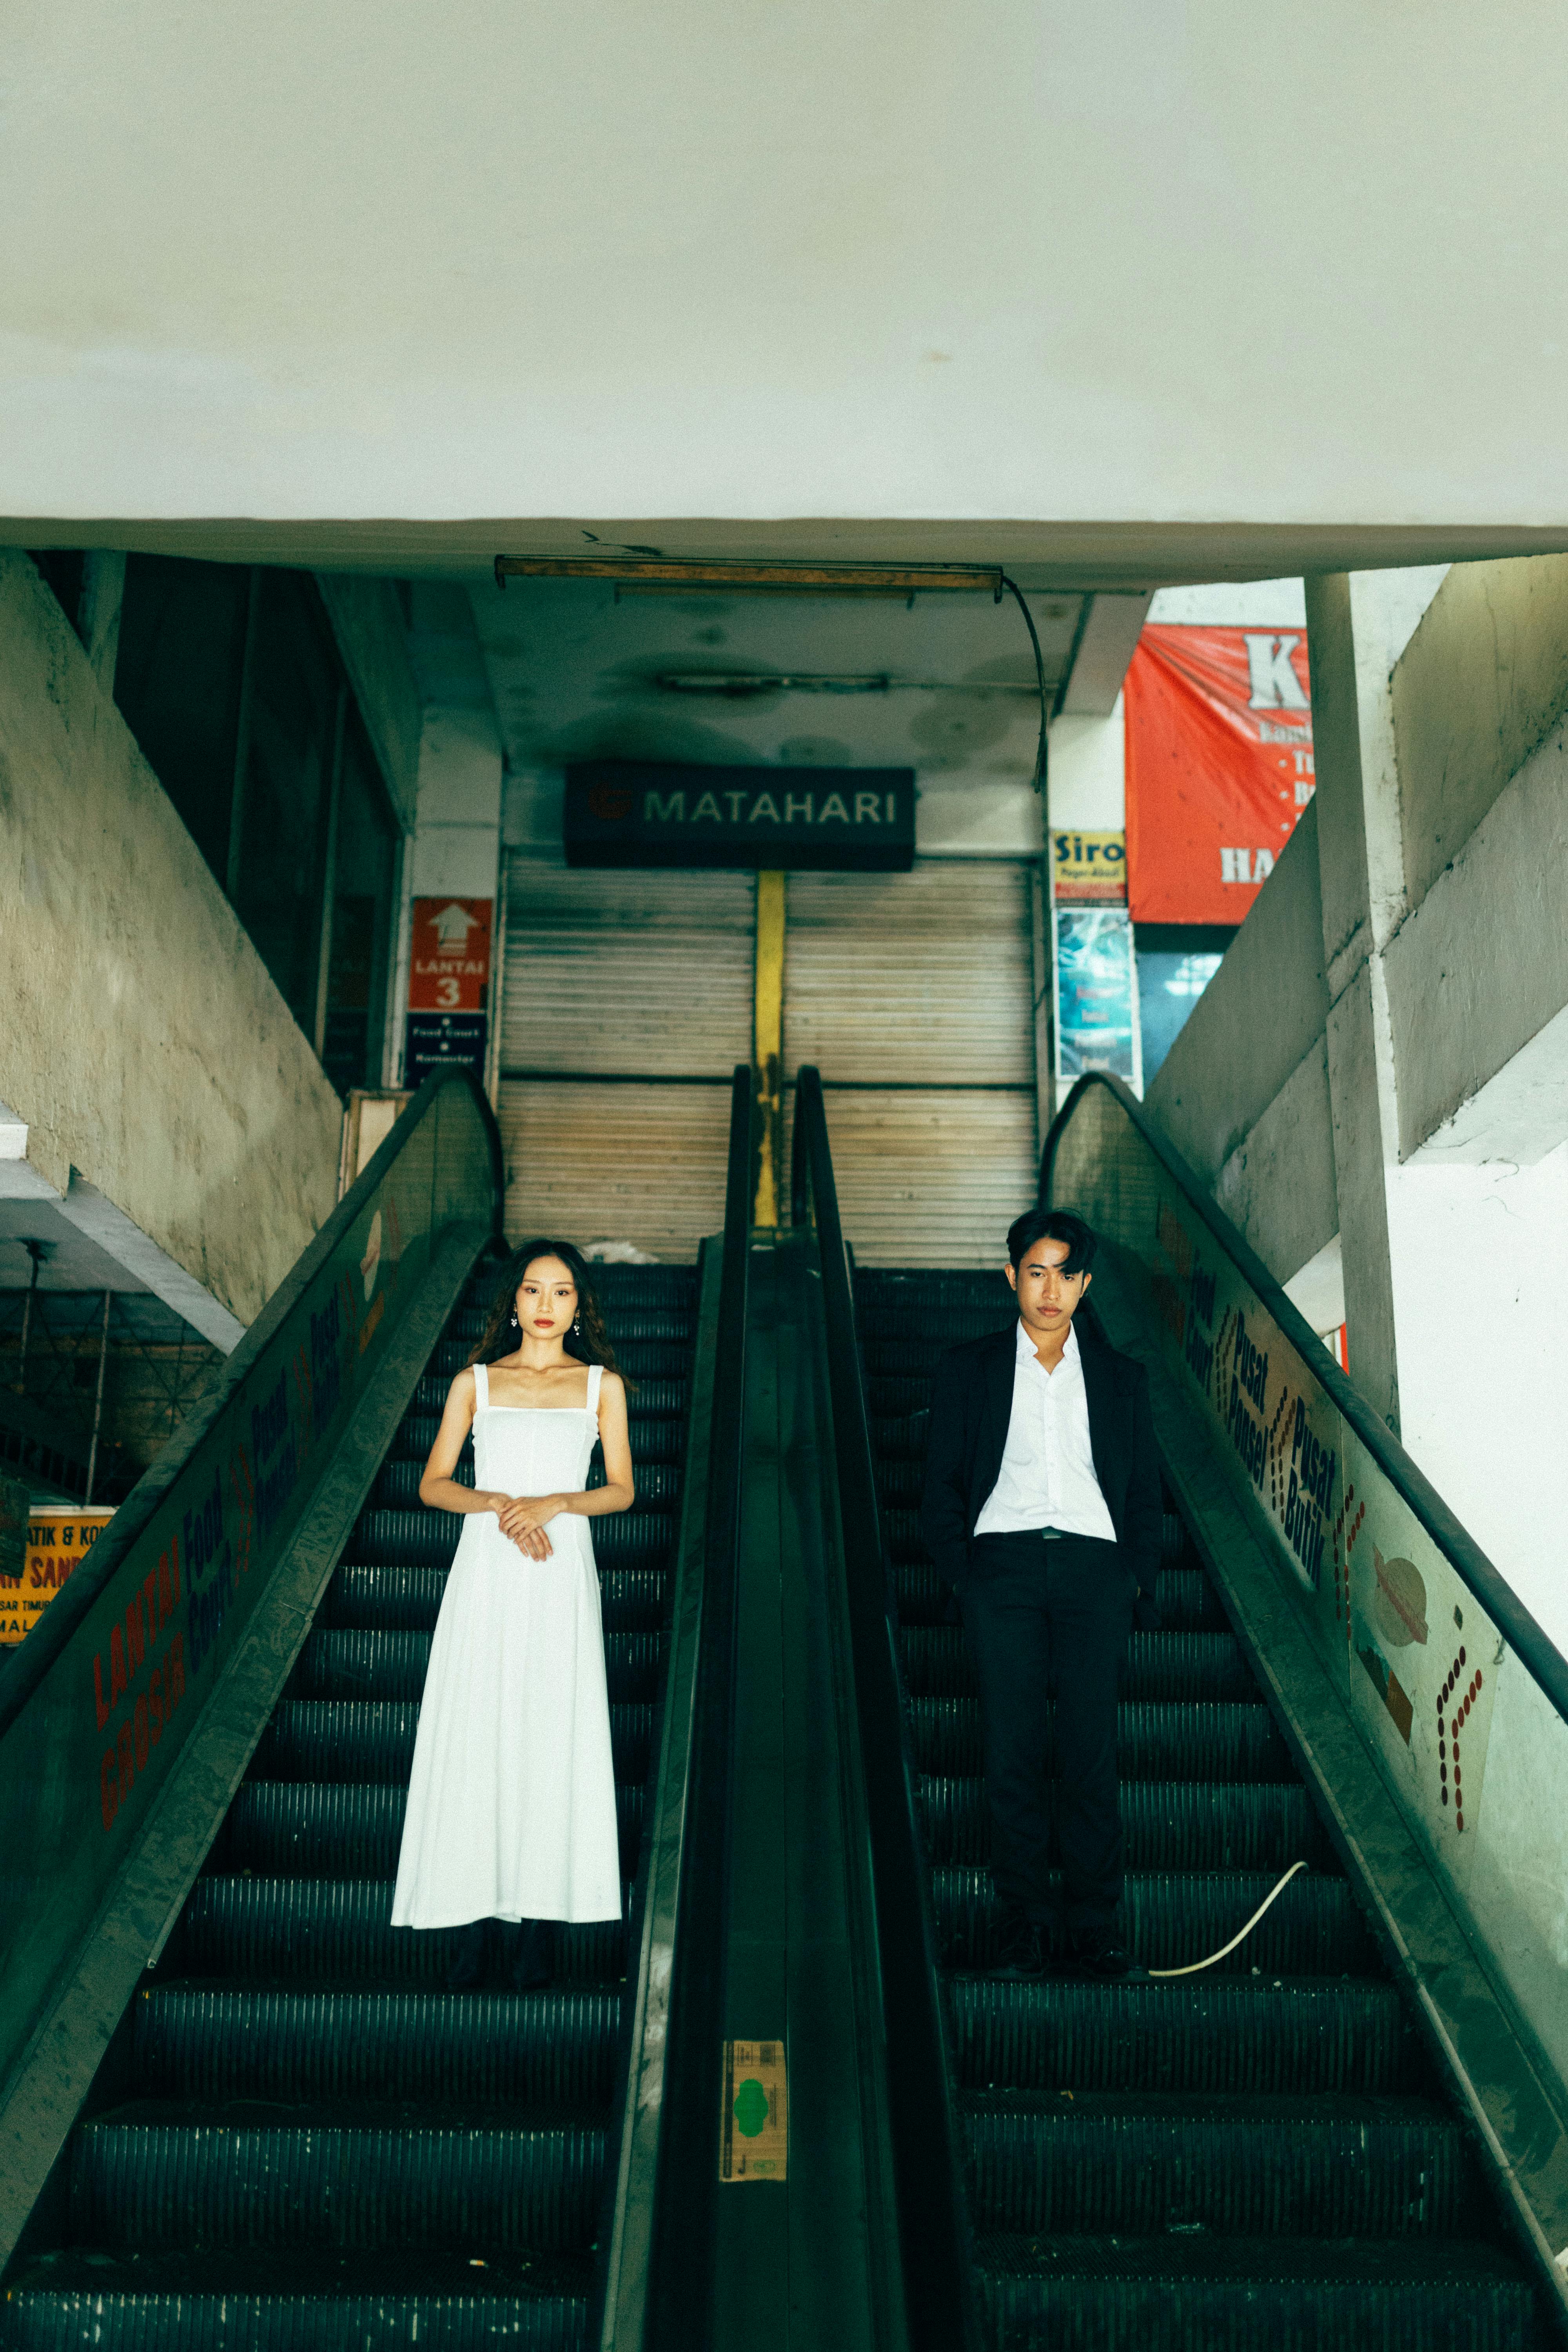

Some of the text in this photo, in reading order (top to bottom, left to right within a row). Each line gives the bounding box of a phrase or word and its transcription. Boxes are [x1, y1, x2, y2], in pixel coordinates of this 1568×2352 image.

[644, 791, 896, 823] MATAHARI
[1056, 835, 1125, 862] Siro
[416, 959, 485, 975] LANTAI
[436, 976, 460, 1007] 3
[1233, 1308, 1268, 1416] Pusat
[1227, 1373, 1269, 1492] Ponsel
[1291, 1395, 1336, 1522] Pusat
[1284, 1466, 1325, 1591] Butik
[93, 1534, 180, 1733] LANTAI
[100, 1631, 185, 1832] GROSIR
